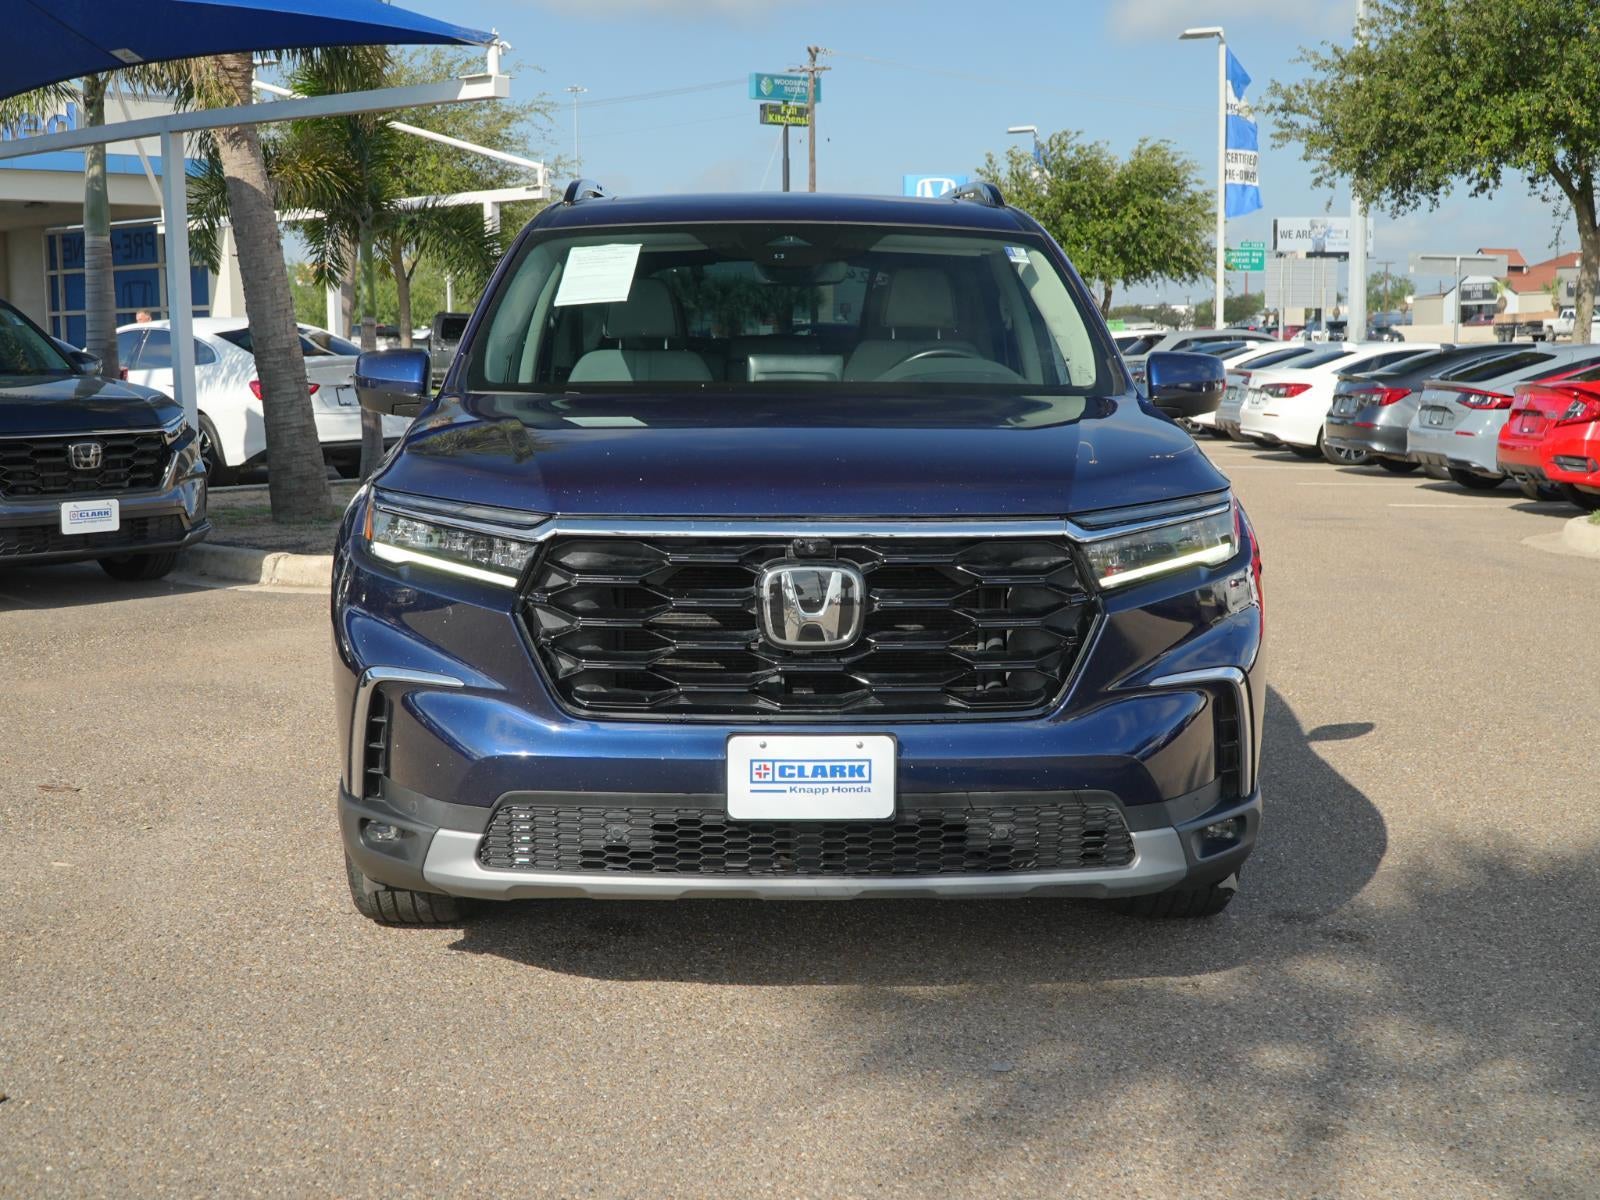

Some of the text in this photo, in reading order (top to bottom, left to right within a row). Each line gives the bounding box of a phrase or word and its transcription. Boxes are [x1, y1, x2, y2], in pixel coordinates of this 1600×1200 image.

[781, 105, 797, 115] Full
[1226, 152, 1257, 167] CERTIFIED
[1280, 230, 1312, 239] WE ARE
[79, 510, 110, 518] CLARK
[778, 764, 866, 779] CLARK
[789, 785, 871, 795] Knapp Honda
